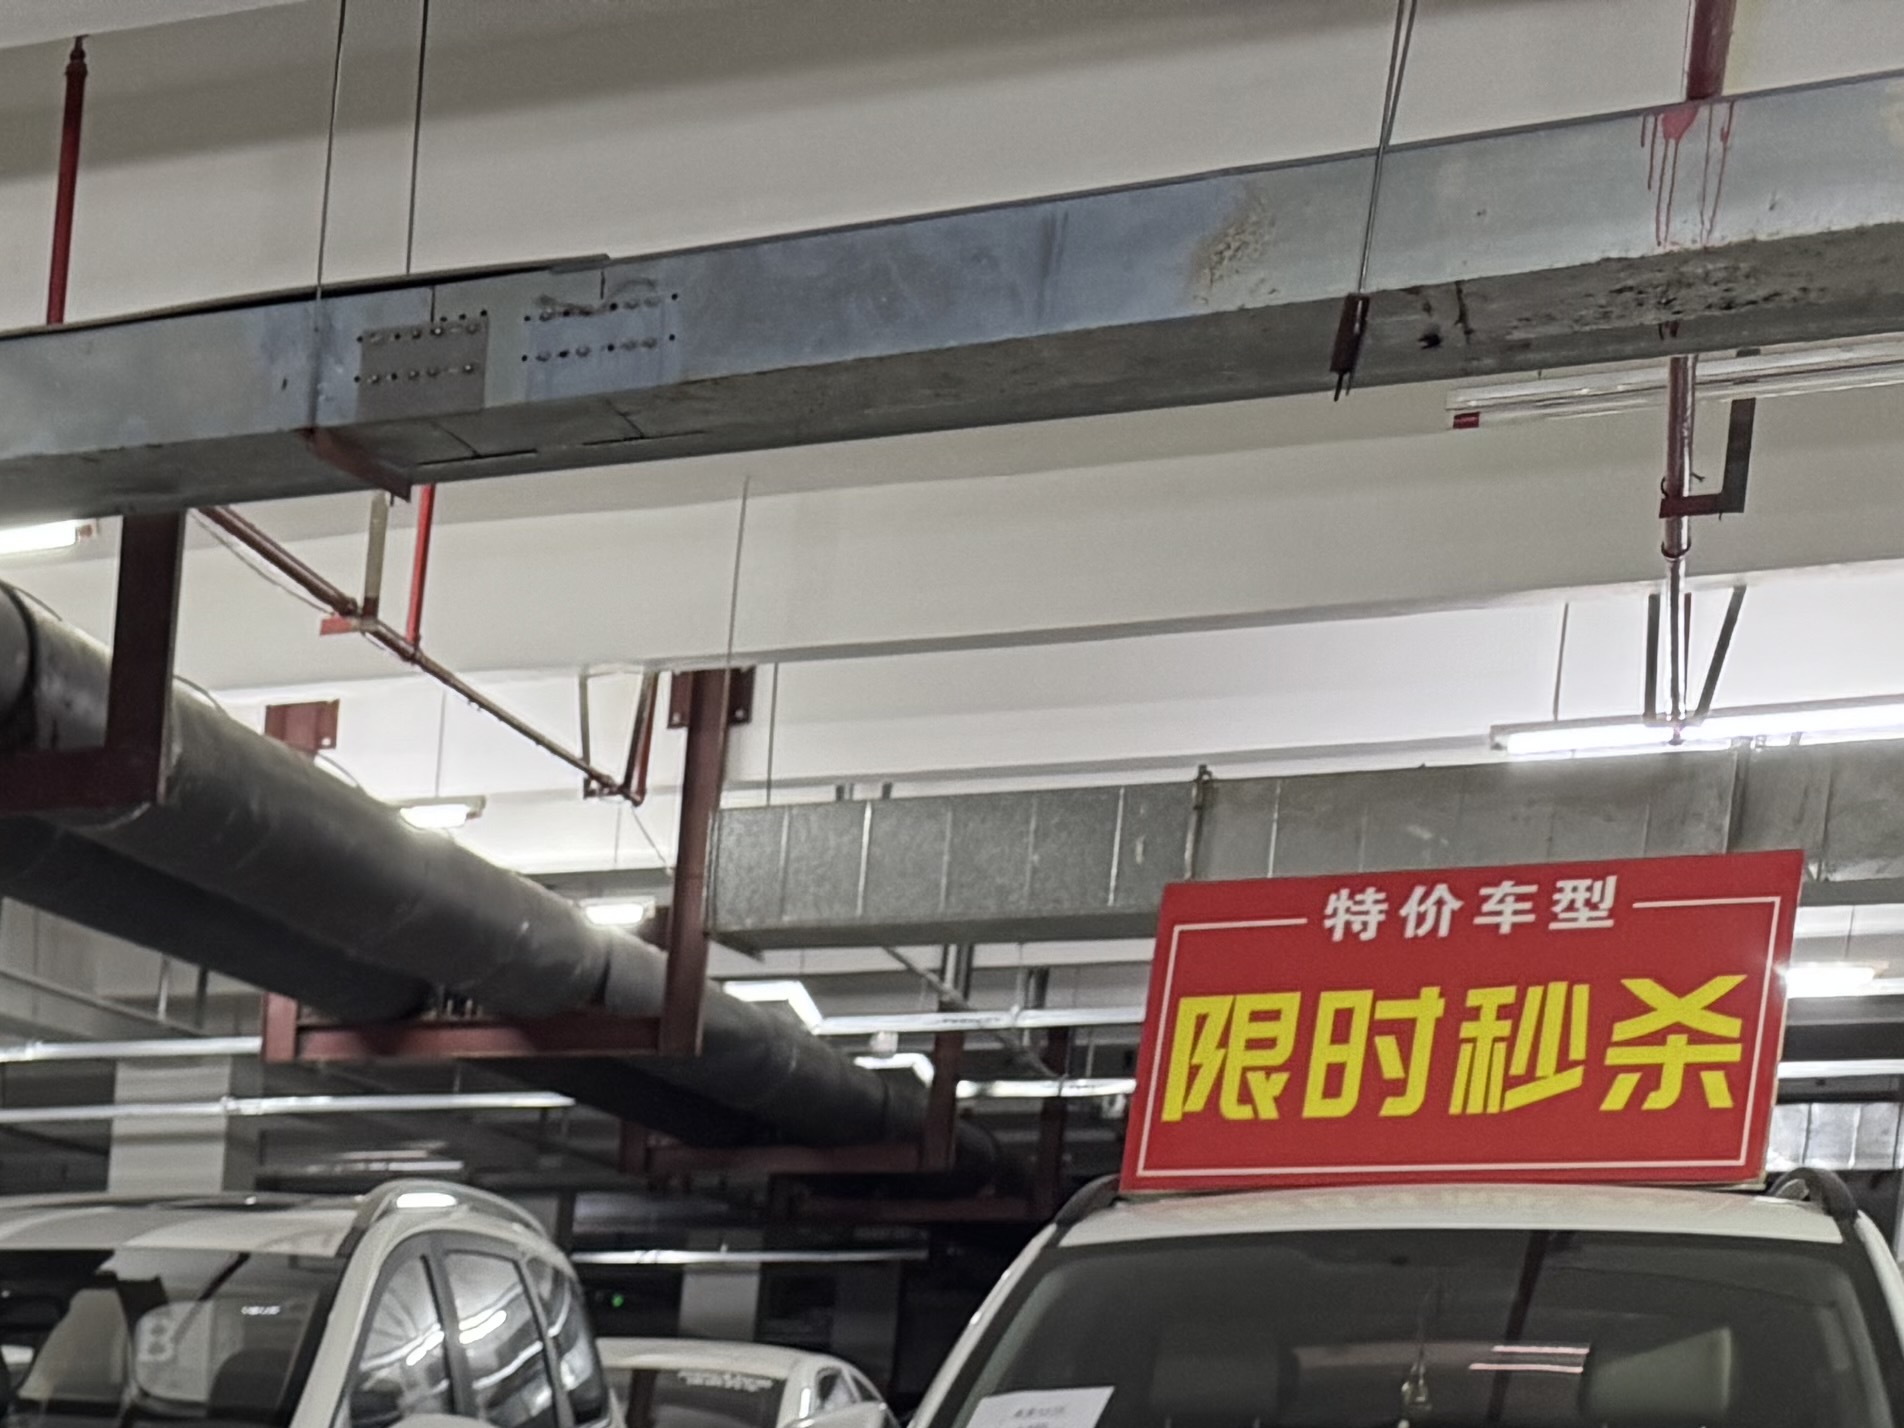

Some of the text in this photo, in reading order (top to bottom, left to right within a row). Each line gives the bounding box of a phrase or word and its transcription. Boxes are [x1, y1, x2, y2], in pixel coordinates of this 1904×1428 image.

[1323, 875, 1619, 942] 特价车型
[1160, 974, 1748, 1123] 限时秒杀
